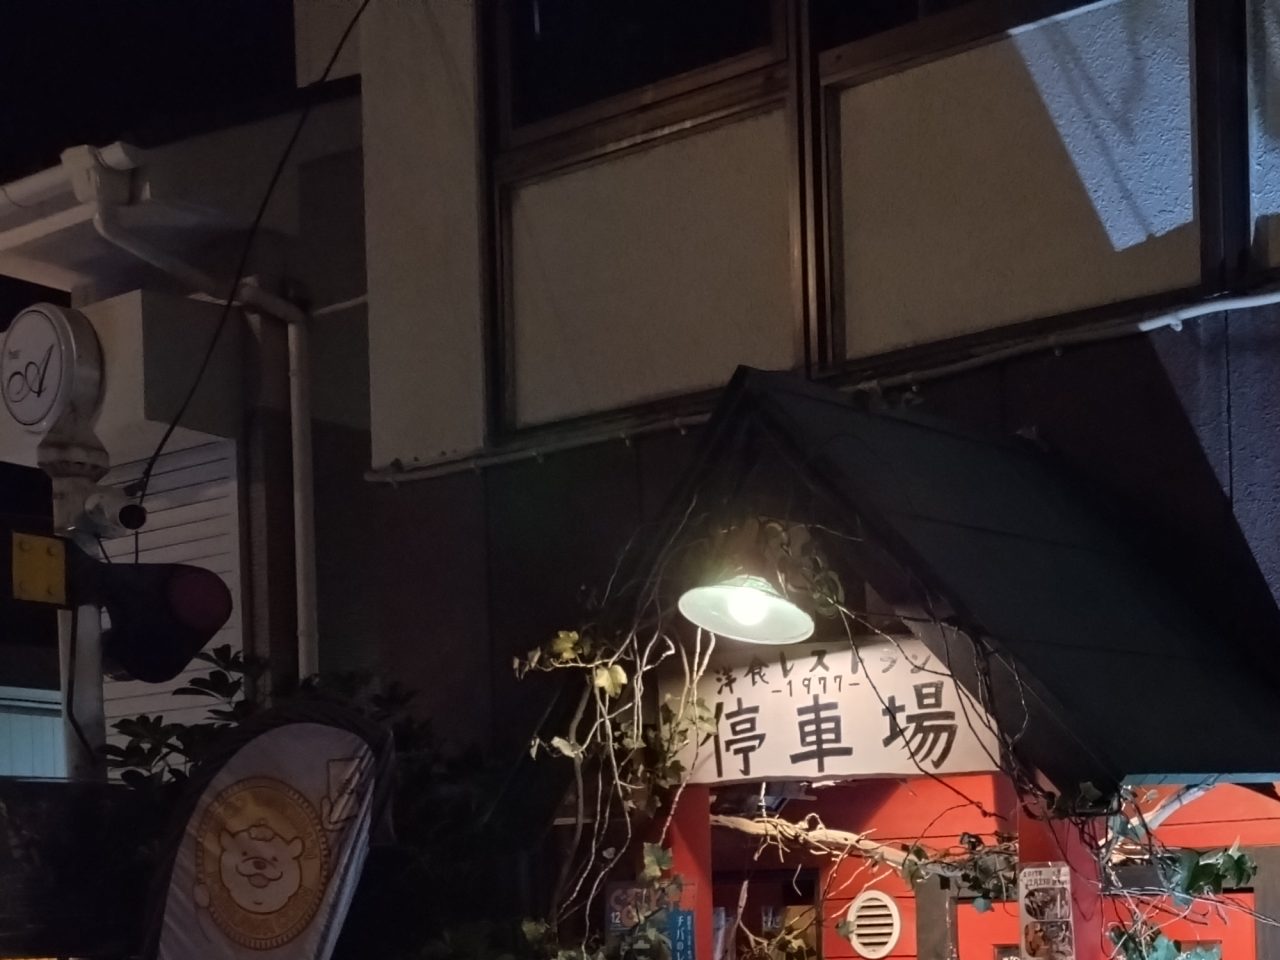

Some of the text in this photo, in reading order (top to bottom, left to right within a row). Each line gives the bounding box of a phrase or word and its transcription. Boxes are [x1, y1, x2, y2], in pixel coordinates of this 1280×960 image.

[714, 649, 932, 695] 洋食レストラン
[714, 681, 959, 778] 停車場
